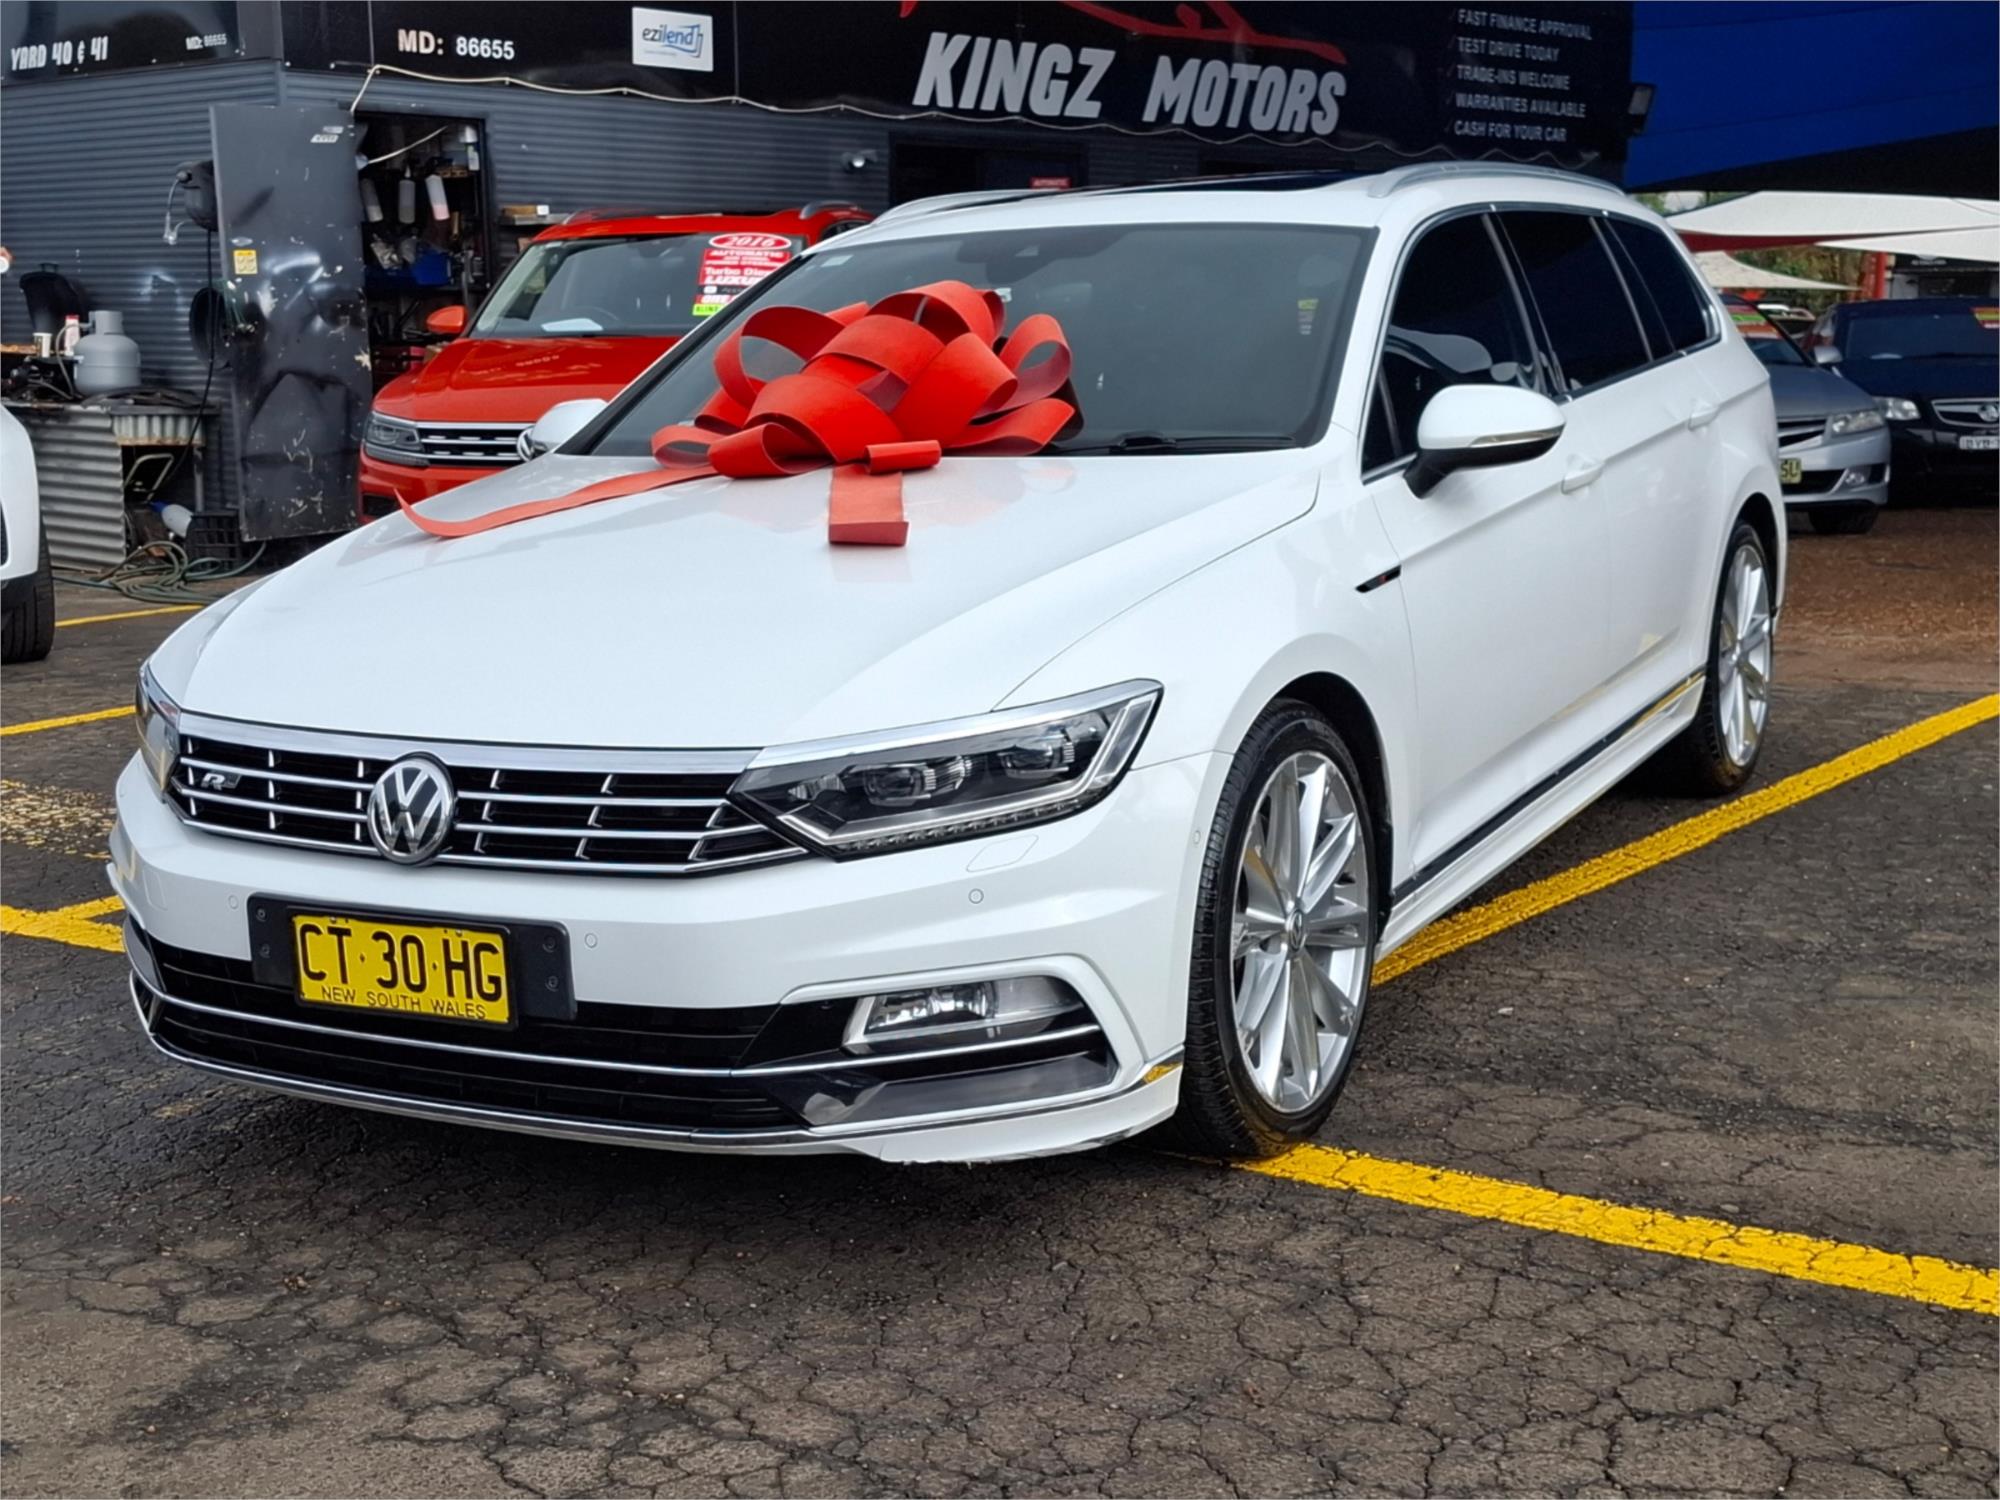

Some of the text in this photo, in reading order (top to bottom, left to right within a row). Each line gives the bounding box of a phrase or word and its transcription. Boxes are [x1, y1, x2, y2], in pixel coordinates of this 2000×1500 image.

[642, 24, 696, 45] ezilend
[1458, 9, 1592, 40] FAST FINANCE APPROVAL
[11, 44, 47, 71] YARD
[52, 41, 73, 66] 40
[91, 36, 108, 61] 41
[398, 29, 515, 60] MD: 86655
[1457, 36, 1560, 61] TEST DRIVE TODAY
[912, 31, 1347, 135] KINGZ MOTORS
[1457, 64, 1570, 90] TRADE-INS WELCOME
[1456, 92, 1587, 118] WARRANTIES AVAILABLE
[1454, 120, 1567, 142] CASH FOR YOUR CAR
[727, 236, 775, 247] 2016
[300, 923, 502, 1002] CT 30 HG
[321, 986, 486, 1019] NEW SOUTH WALES
